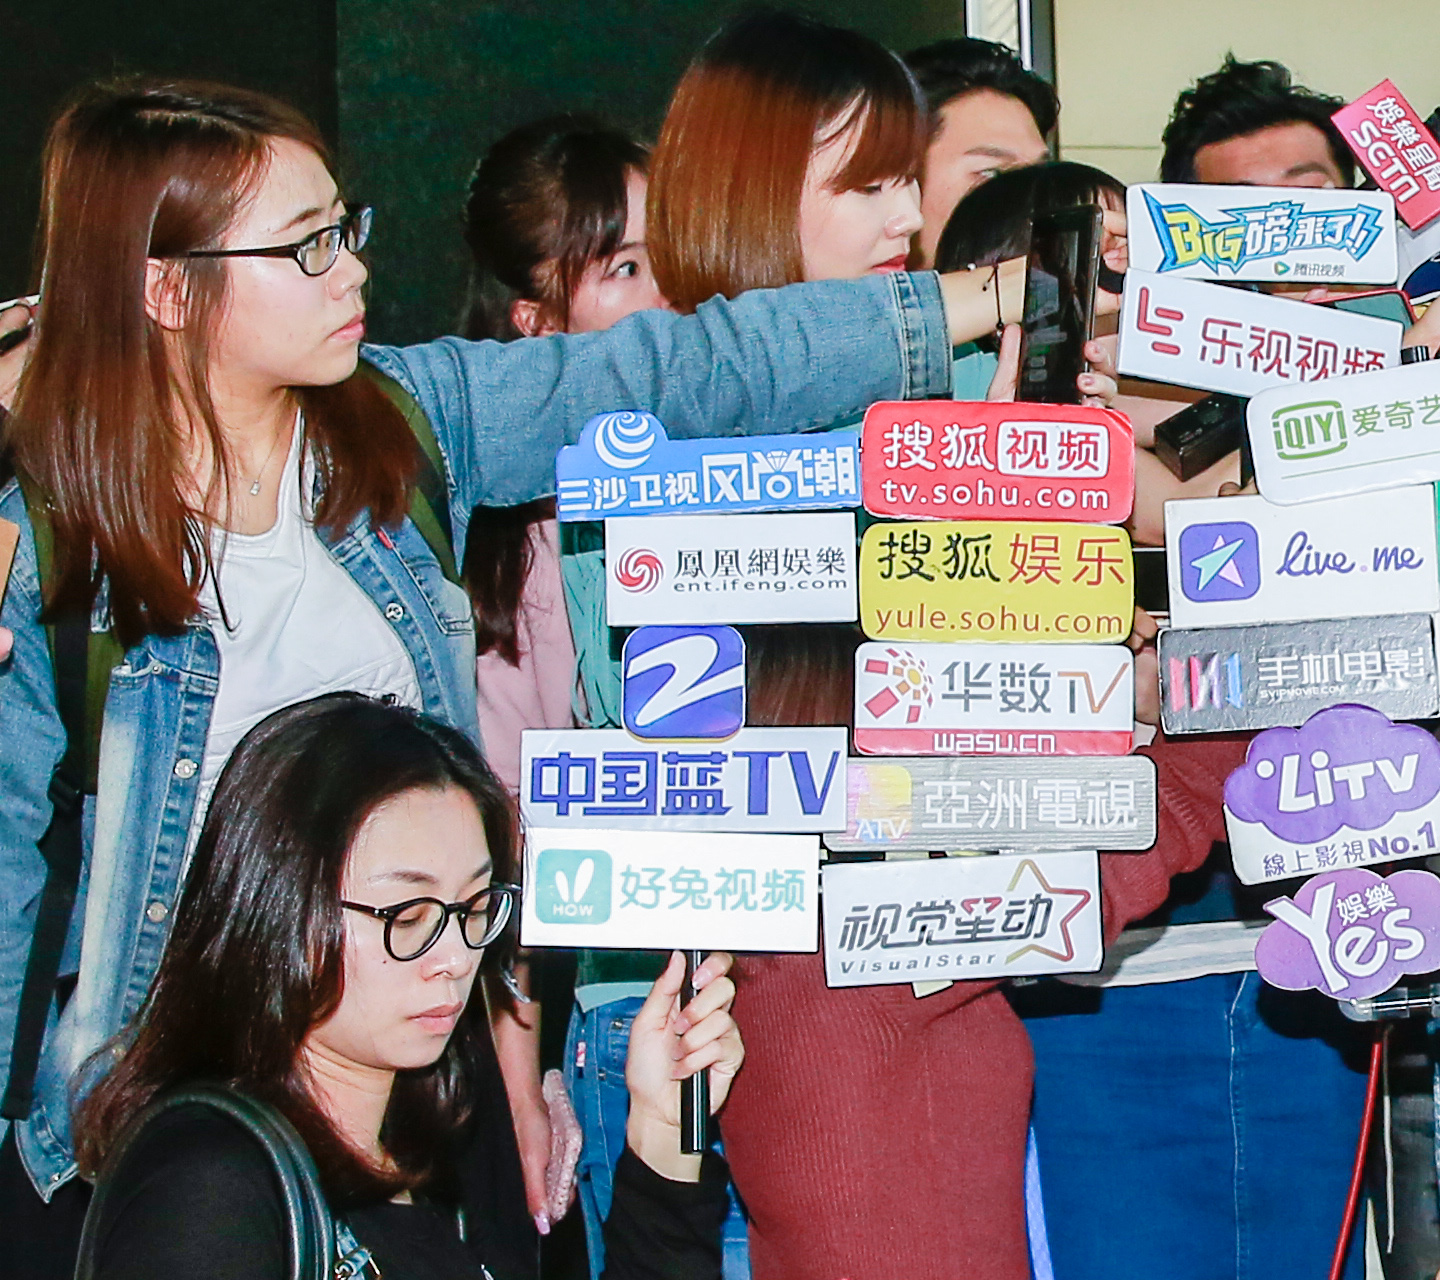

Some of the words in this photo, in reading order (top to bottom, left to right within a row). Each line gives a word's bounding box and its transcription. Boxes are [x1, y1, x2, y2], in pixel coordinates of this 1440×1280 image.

[1200, 317, 1386, 382] 乐视视频
[882, 421, 1109, 475] 搜狐视频
[559, 471, 700, 512] 三沙卫视
[881, 478, 1109, 510] tv.sohu.com
[878, 528, 1126, 586] 搜狐娱乐
[673, 577, 848, 593] ent.ifeng.com
[875, 602, 1123, 634] yule.sohu.com
[941, 660, 1130, 713] 华数TV
[934, 732, 1056, 753] wasu.cn
[529, 750, 841, 817] 中国蓝TV
[921, 778, 1139, 831] 亞洲電視
[856, 818, 909, 840] ATV
[1262, 839, 1365, 878] 線上影視
[1368, 821, 1437, 859] No.1
[552, 903, 594, 917] HOW
[619, 864, 807, 913] 好兔视频
[1263, 881, 1426, 994] Yes
[840, 952, 997, 974] VisualStar
